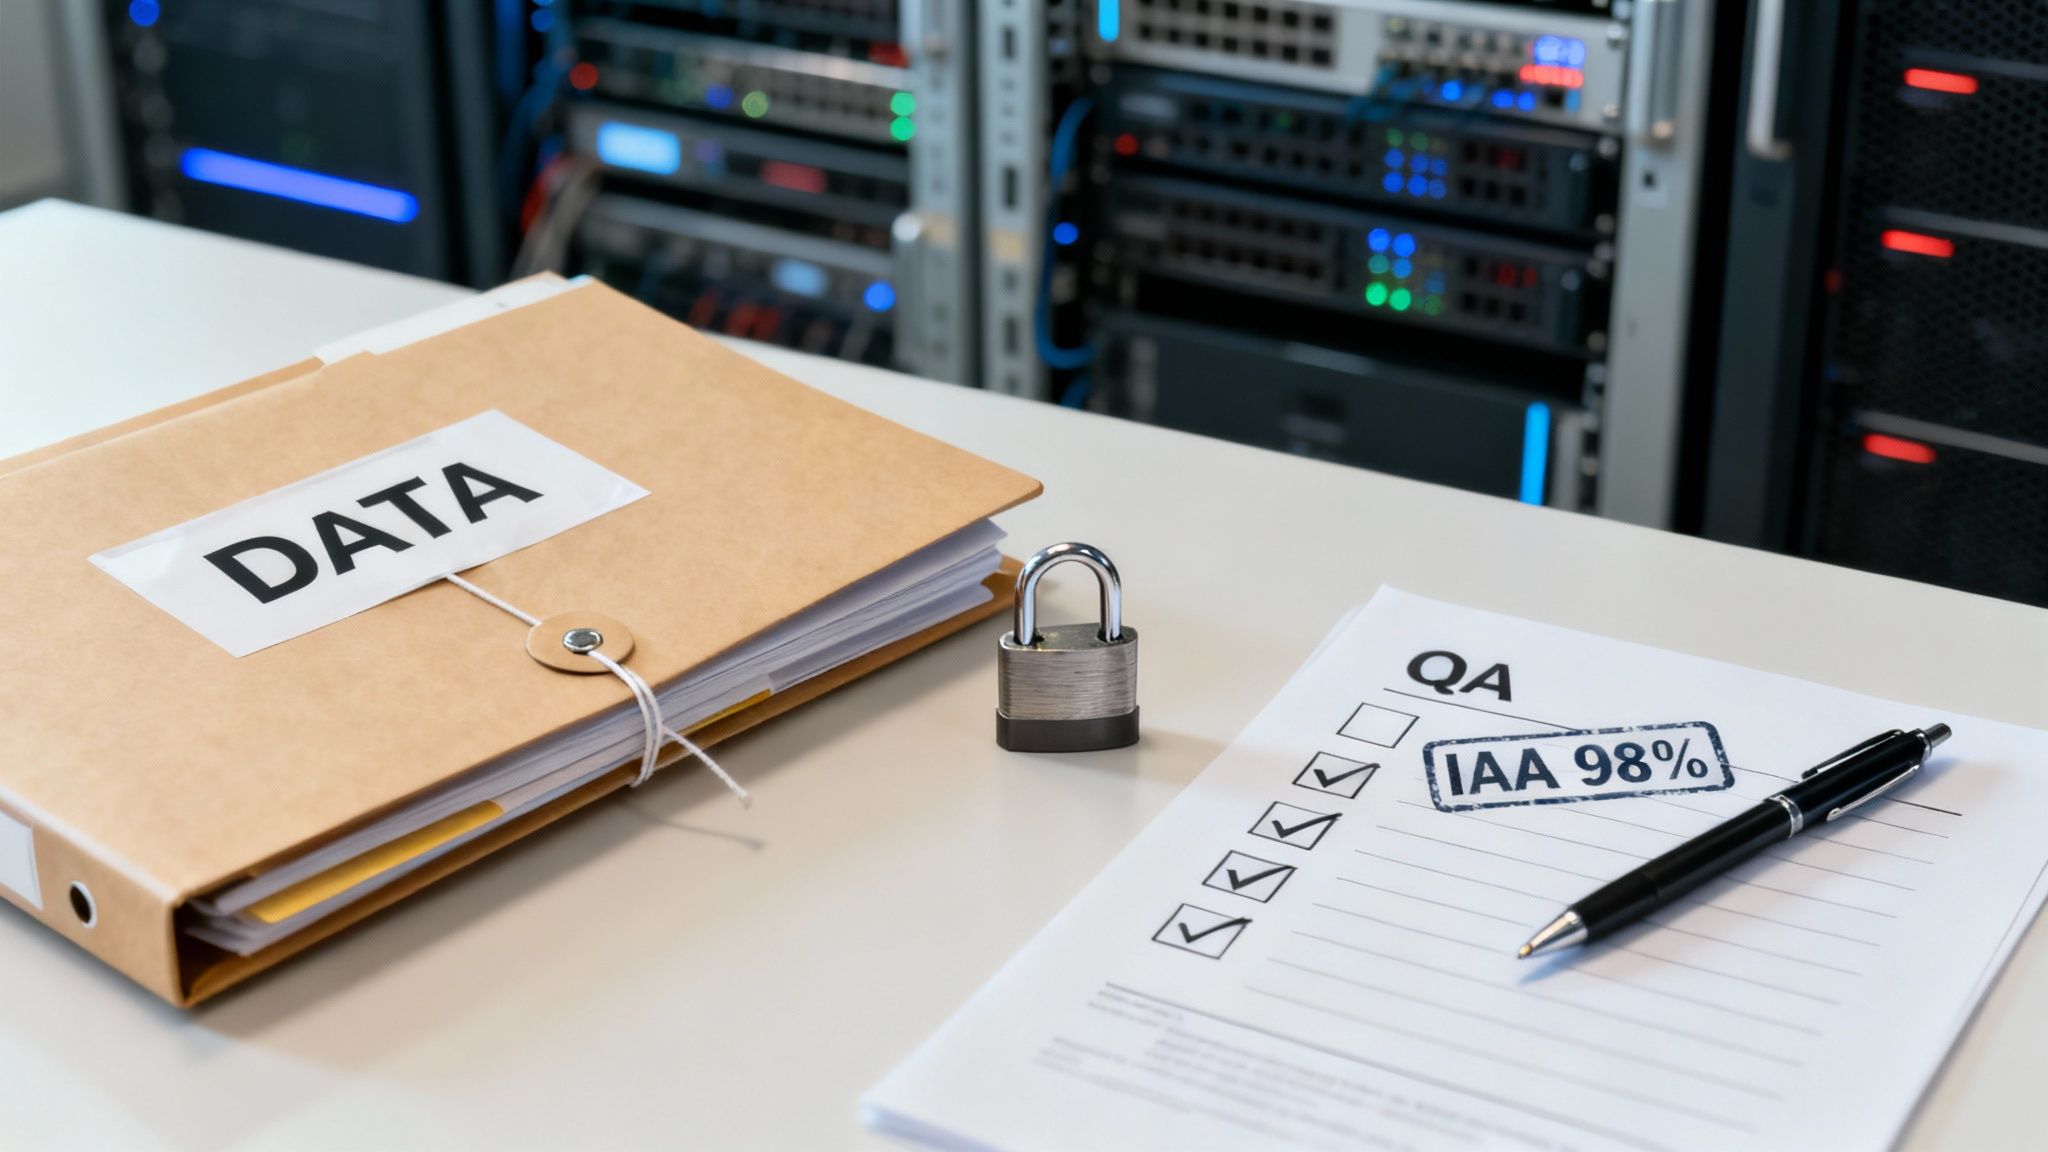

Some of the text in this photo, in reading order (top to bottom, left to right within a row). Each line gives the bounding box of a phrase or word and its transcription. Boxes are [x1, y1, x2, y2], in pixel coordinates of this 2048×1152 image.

[204, 462, 543, 604] DATA
[1407, 650, 1512, 702] QA
[1445, 738, 1709, 796] IAA 98%
